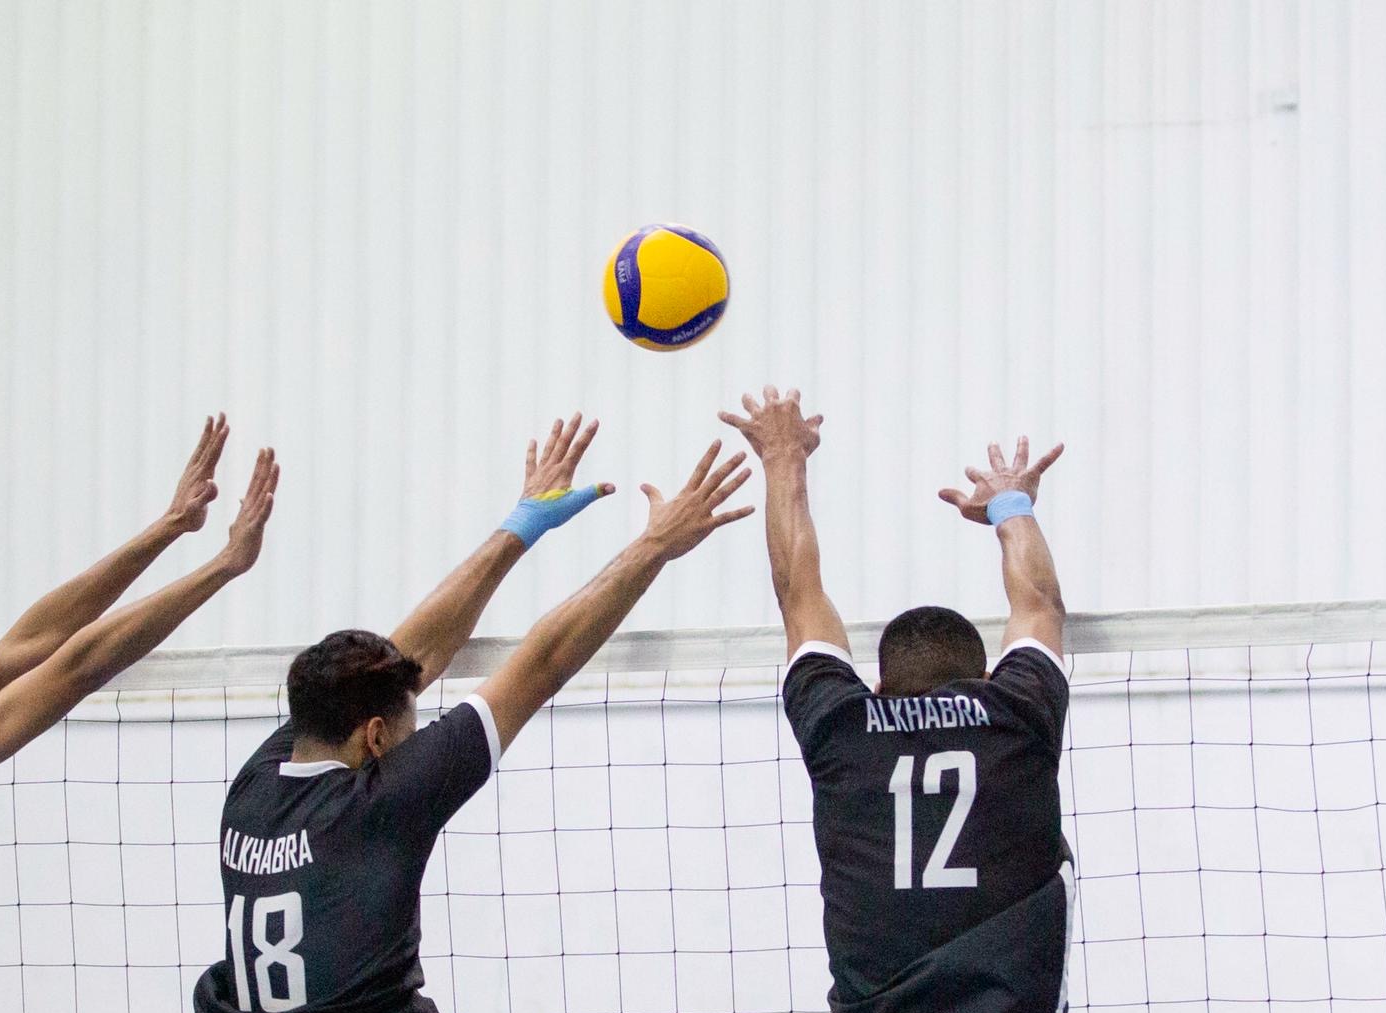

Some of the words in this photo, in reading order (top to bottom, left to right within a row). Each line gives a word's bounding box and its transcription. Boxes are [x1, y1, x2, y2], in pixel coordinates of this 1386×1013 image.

[866, 694, 992, 733] ALKHABRA
[222, 826, 314, 875] ALKHABRA
[888, 749, 979, 890] 12
[227, 890, 307, 1013] 18
